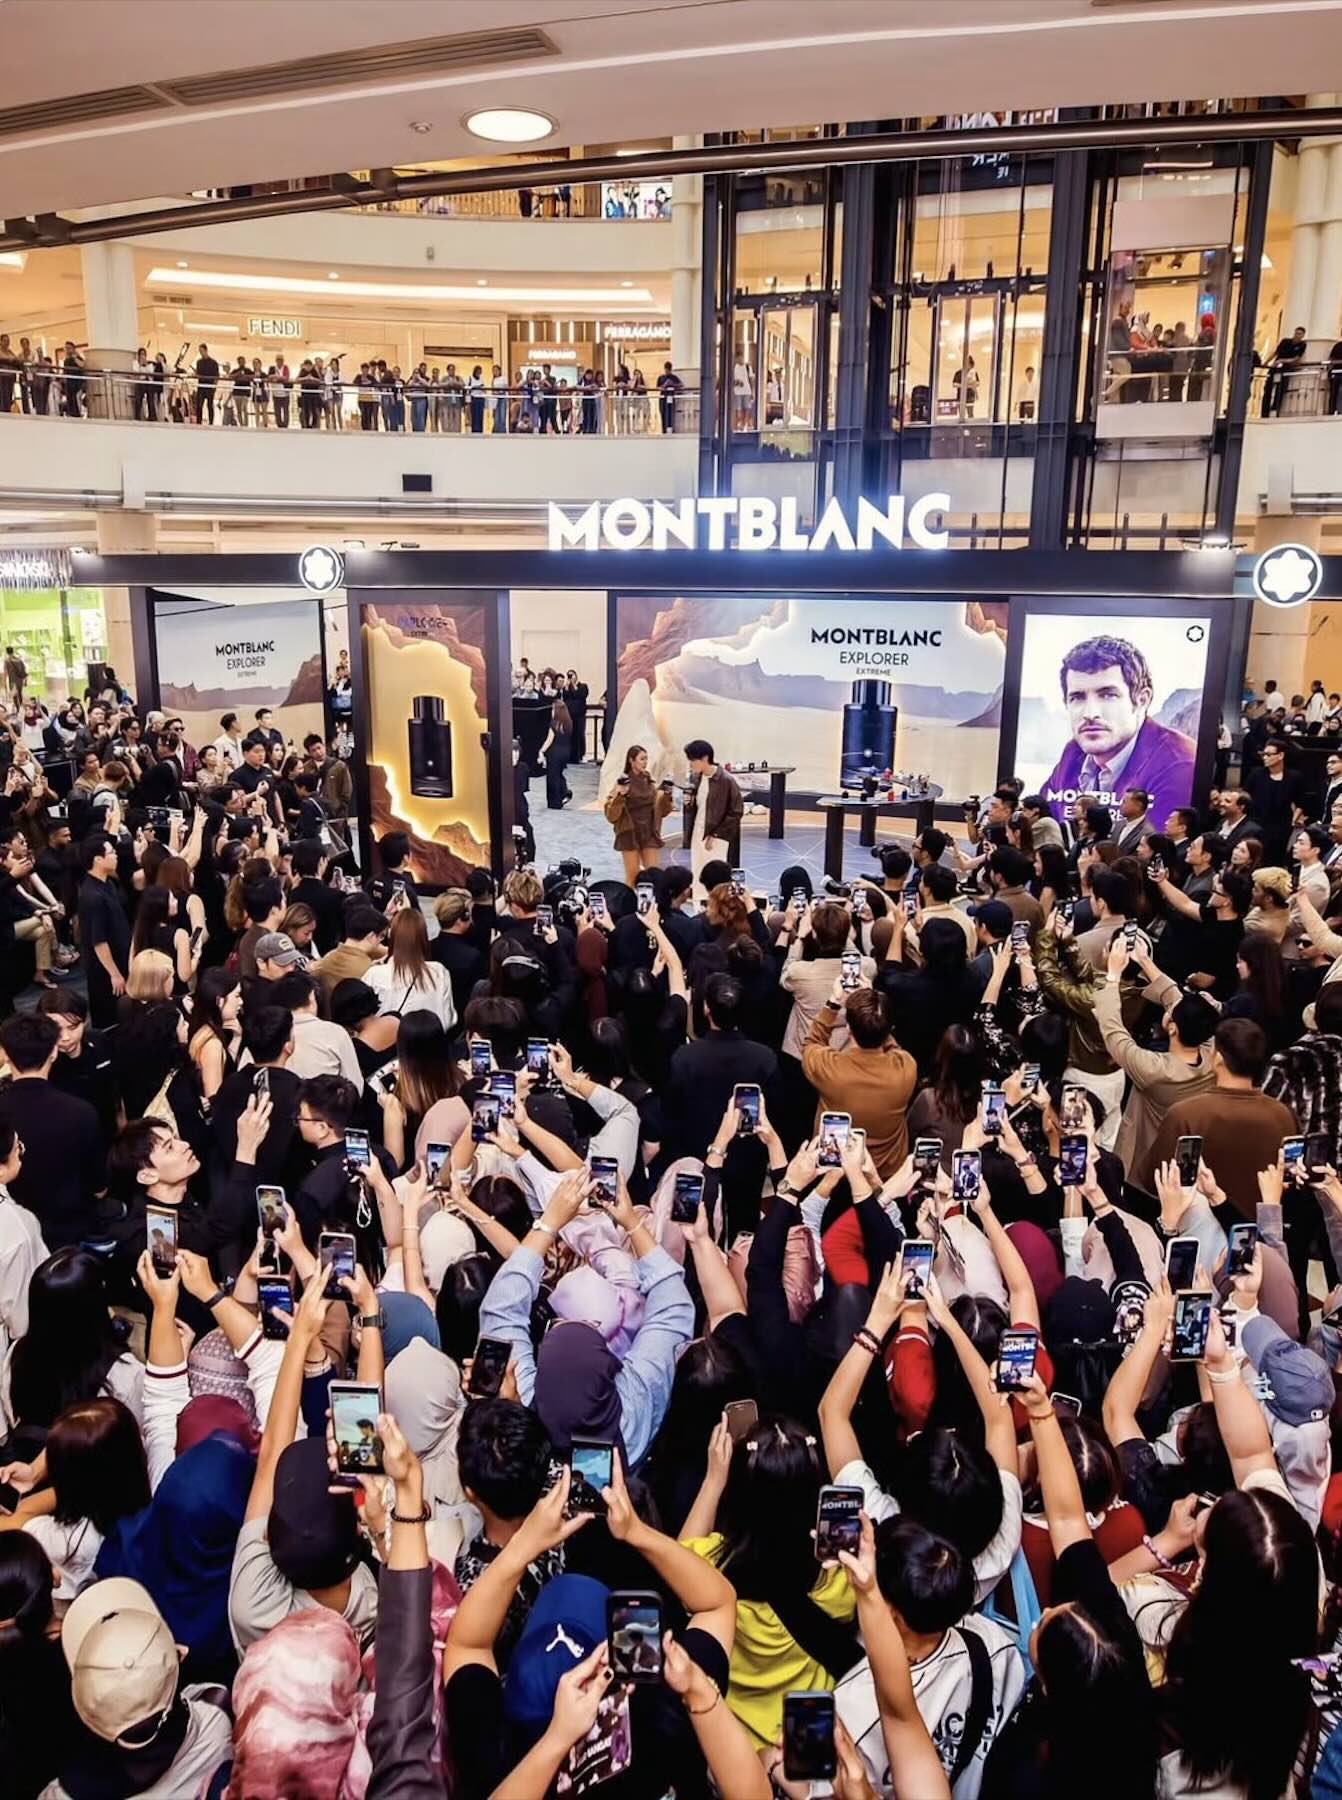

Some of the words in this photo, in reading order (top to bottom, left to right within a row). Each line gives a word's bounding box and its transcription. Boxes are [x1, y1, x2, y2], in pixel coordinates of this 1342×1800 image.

[248, 318, 301, 337] FENDI
[547, 493, 952, 552] MONTBLANC
[811, 628, 942, 647] MONTBLANC
[215, 640, 275, 657] MONTBLANC
[227, 656, 265, 670] EXPLORER
[840, 651, 909, 666] EXPLORER
[855, 667, 892, 676] EXTREME
